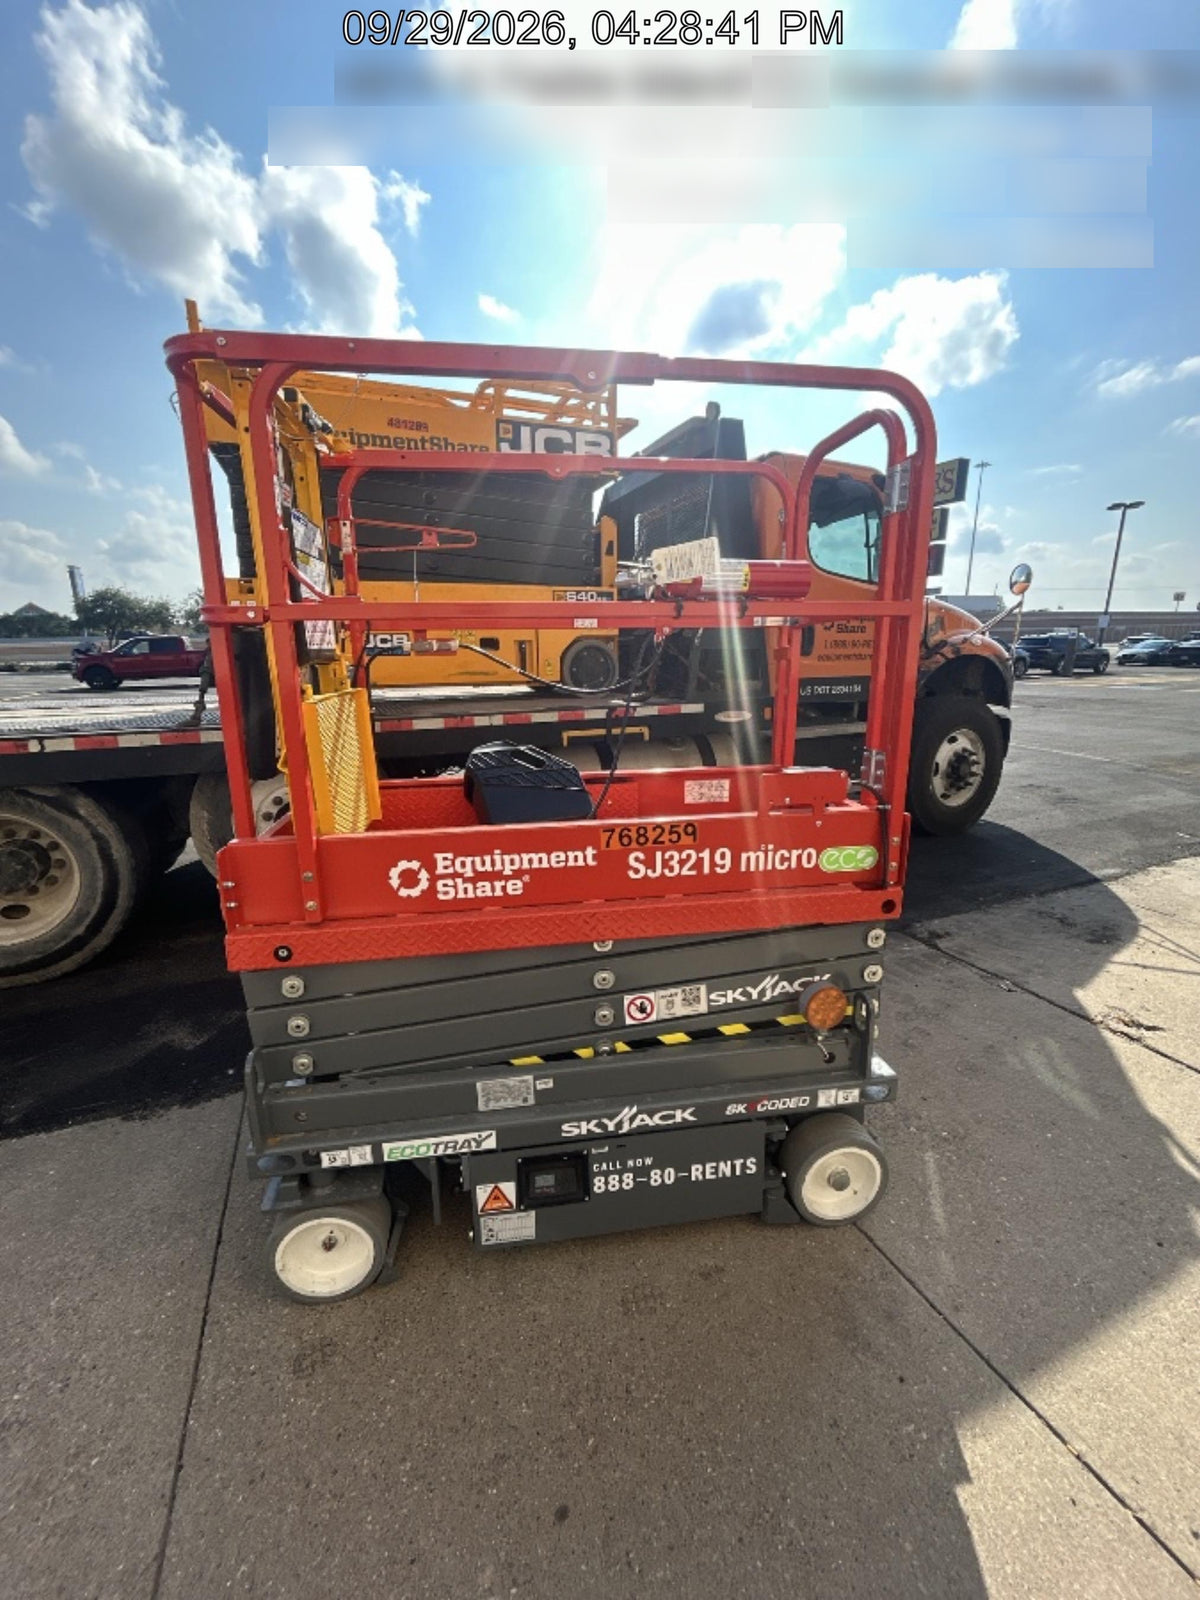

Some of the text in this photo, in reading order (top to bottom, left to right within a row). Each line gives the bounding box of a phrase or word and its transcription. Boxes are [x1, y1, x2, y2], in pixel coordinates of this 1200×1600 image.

[499, 425, 612, 457] JCB
[366, 634, 409, 648] JCB
[601, 823, 698, 848] 768259
[434, 846, 598, 877] Equipment
[627, 847, 732, 879] SJ3219
[739, 844, 817, 872] micro
[708, 973, 832, 1006] SKYJAC
[560, 1104, 698, 1137] SKYJACK
[386, 1132, 494, 1160] ECOTRAY
[593, 1157, 653, 1172] CALL NOW
[593, 1157, 757, 1194] 888-80-RENTS
